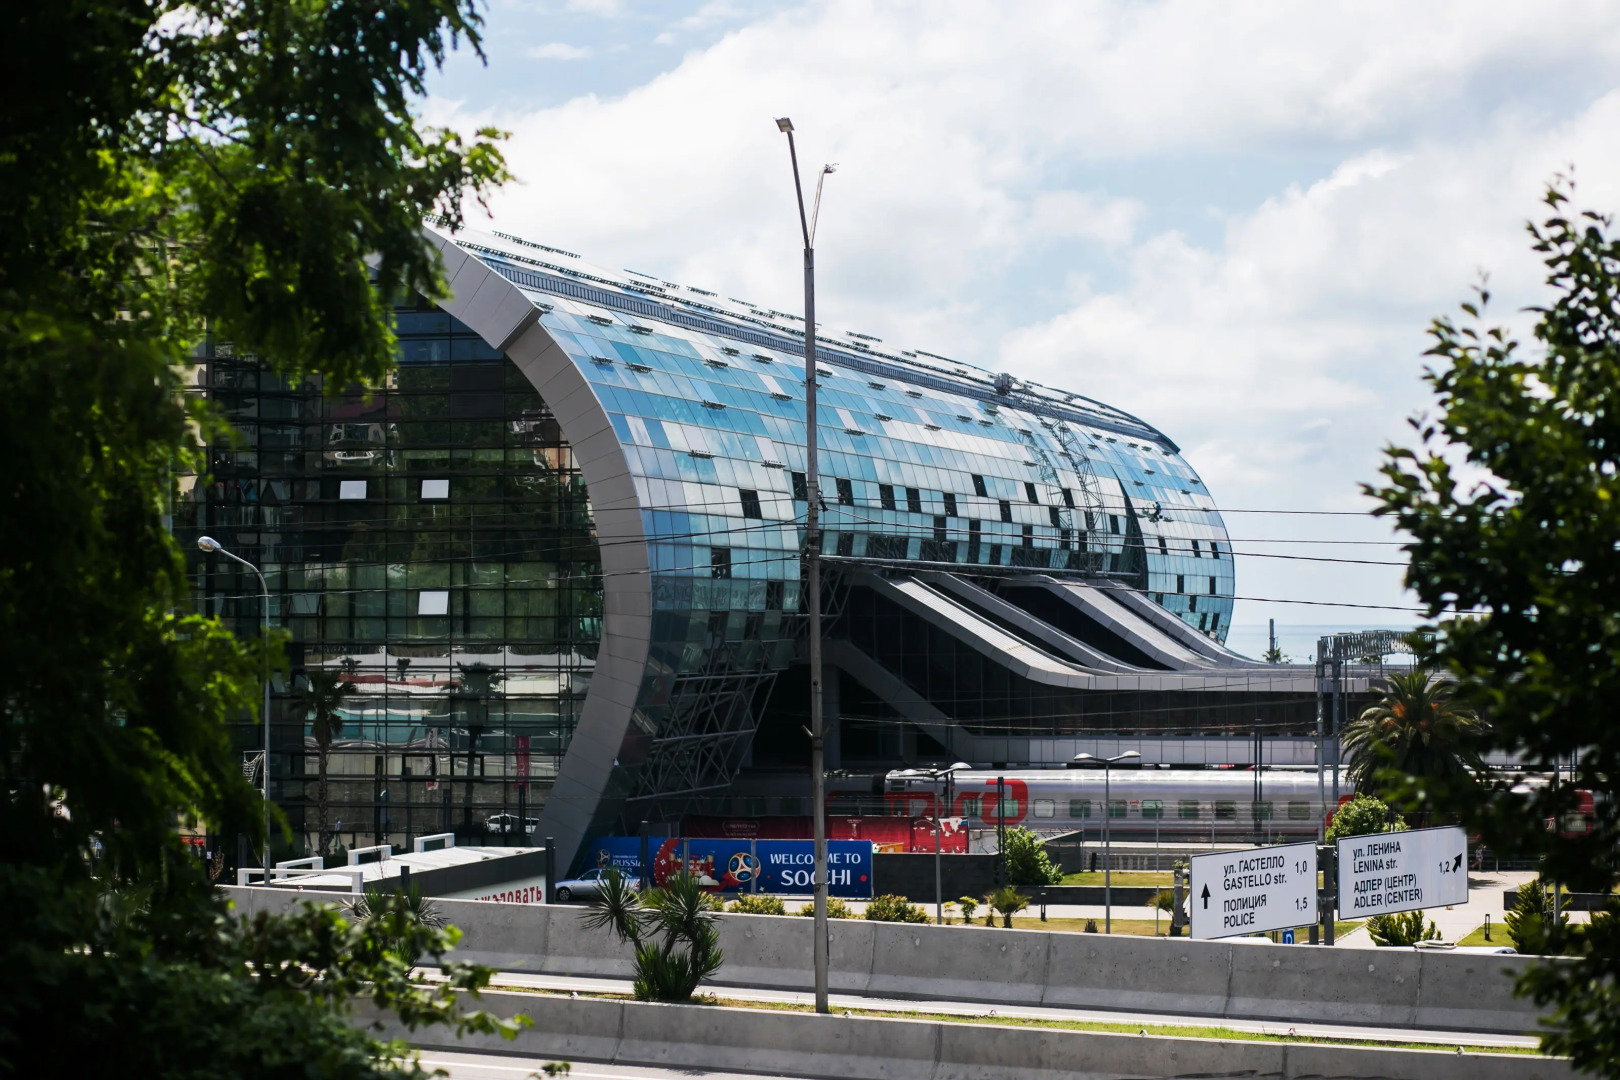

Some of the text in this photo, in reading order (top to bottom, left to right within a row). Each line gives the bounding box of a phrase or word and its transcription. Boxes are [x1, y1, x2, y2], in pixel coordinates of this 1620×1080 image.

[844, 853, 861, 864] TO
[1353, 841, 1402, 861] ул. ЛЕНИНА
[1223, 855, 1285, 878] ул. ГАСТЕЛЛО
[1295, 860, 1308, 875] 1,0
[1353, 858, 1398, 874] LENINA str.
[1439, 861, 1450, 874] 1,2
[1223, 873, 1287, 891] GASTELLO str.
[1353, 873, 1417, 894] АДЛЕР (ЦЕНТР)
[1223, 894, 1267, 912] ПОЛИЦИЯ
[1295, 897, 1308, 911] 1,5
[1354, 888, 1423, 909] ADLER (CENTER)
[1223, 912, 1255, 928] POLICE
